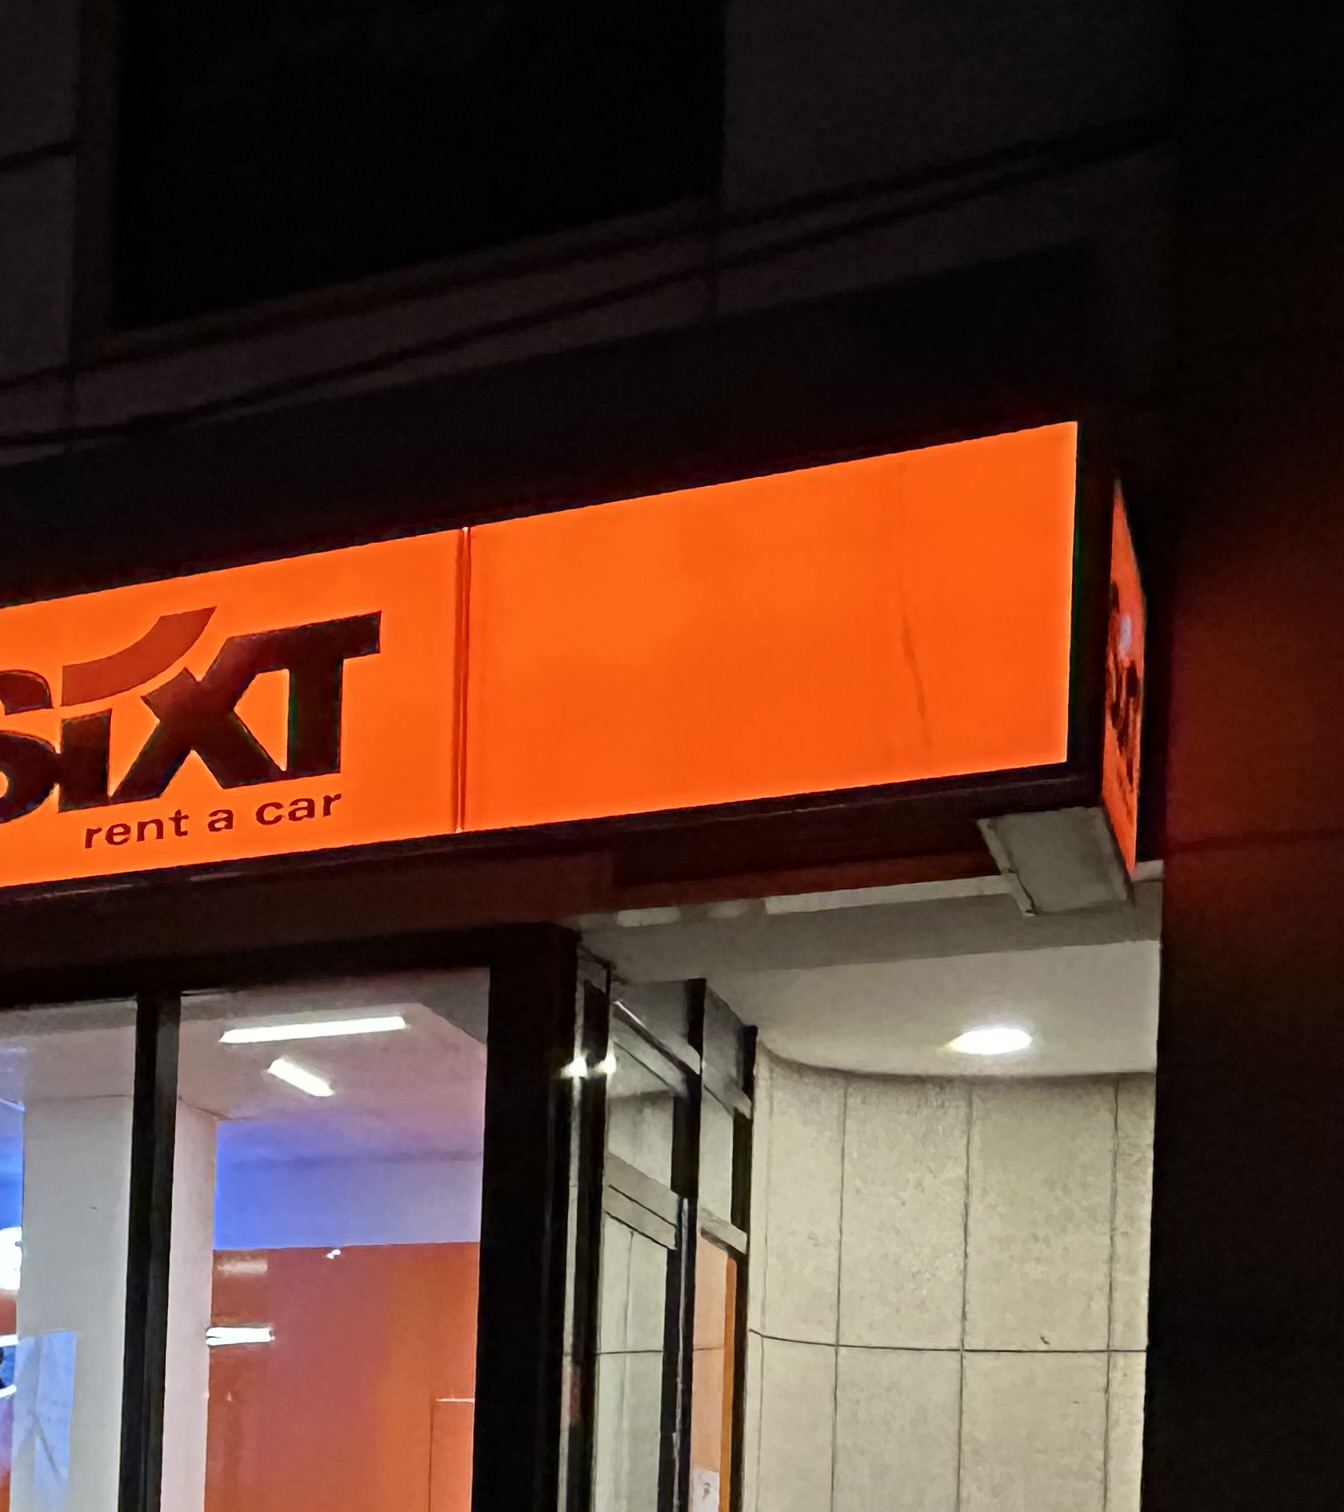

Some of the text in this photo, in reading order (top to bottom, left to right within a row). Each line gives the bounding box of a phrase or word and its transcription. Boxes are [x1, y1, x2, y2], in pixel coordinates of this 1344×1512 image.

[84, 793, 342, 850] rent a car
